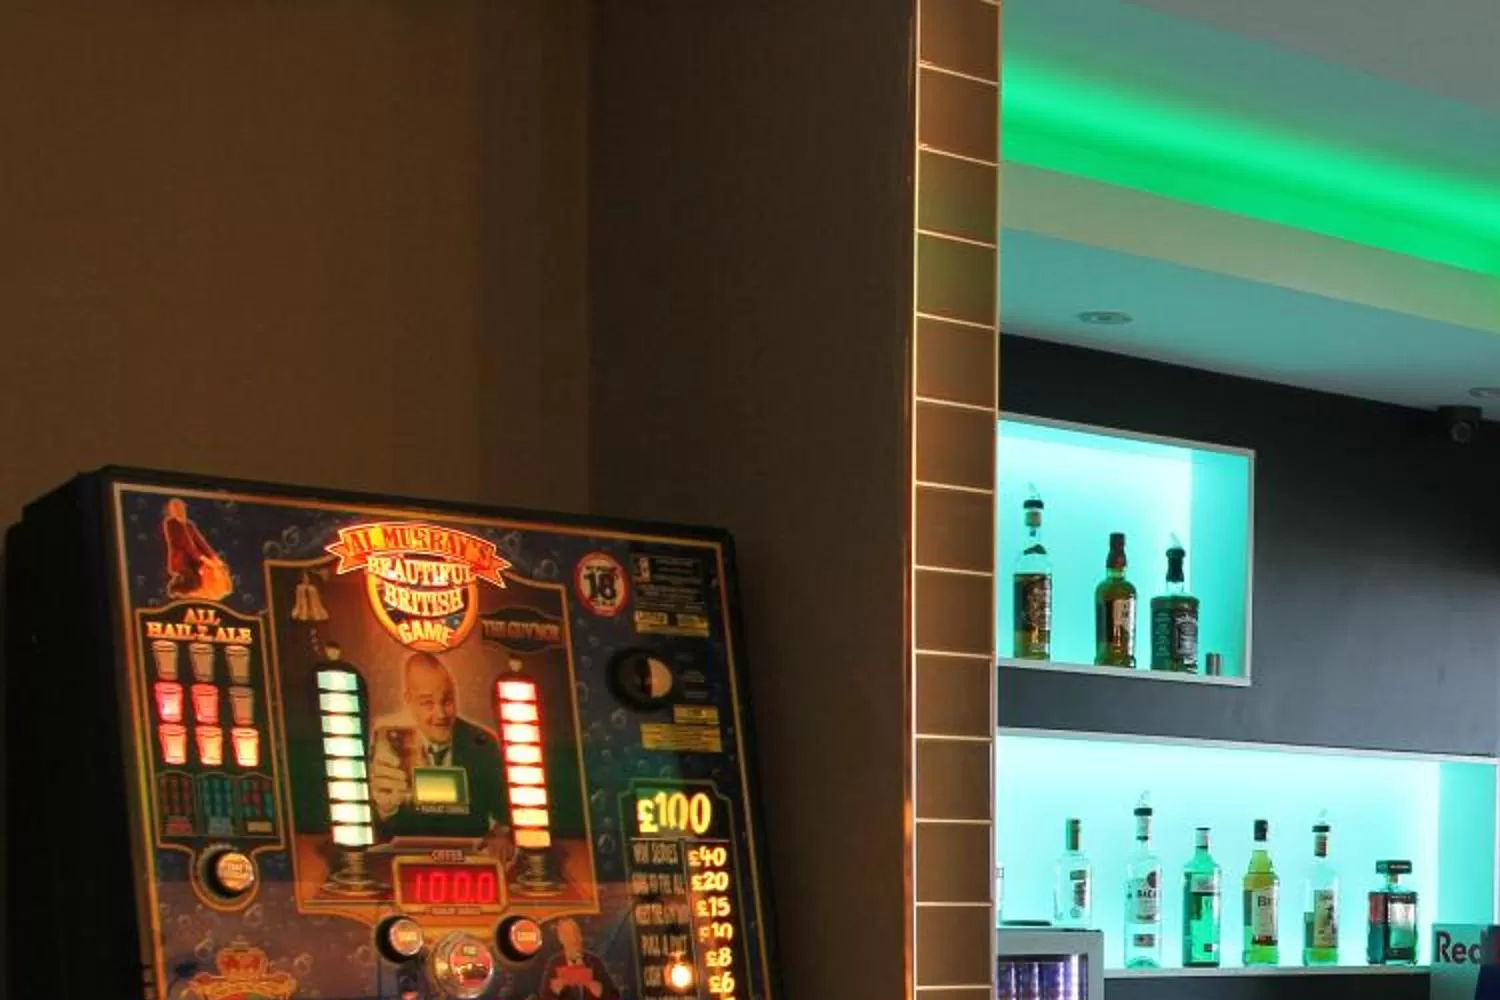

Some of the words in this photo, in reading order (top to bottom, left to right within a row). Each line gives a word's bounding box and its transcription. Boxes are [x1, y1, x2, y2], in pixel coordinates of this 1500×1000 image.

[367, 556, 476, 587] BEAUTIFUL
[383, 582, 465, 616] BRITISH
[183, 607, 221, 626] ALL
[398, 619, 456, 647] GAME
[636, 790, 713, 835] £100
[686, 845, 728, 868] £40
[690, 870, 730, 892] £20
[696, 895, 732, 918] £15
[705, 946, 733, 968] £8
[1435, 927, 1489, 966] Red
[708, 971, 736, 994] £6
